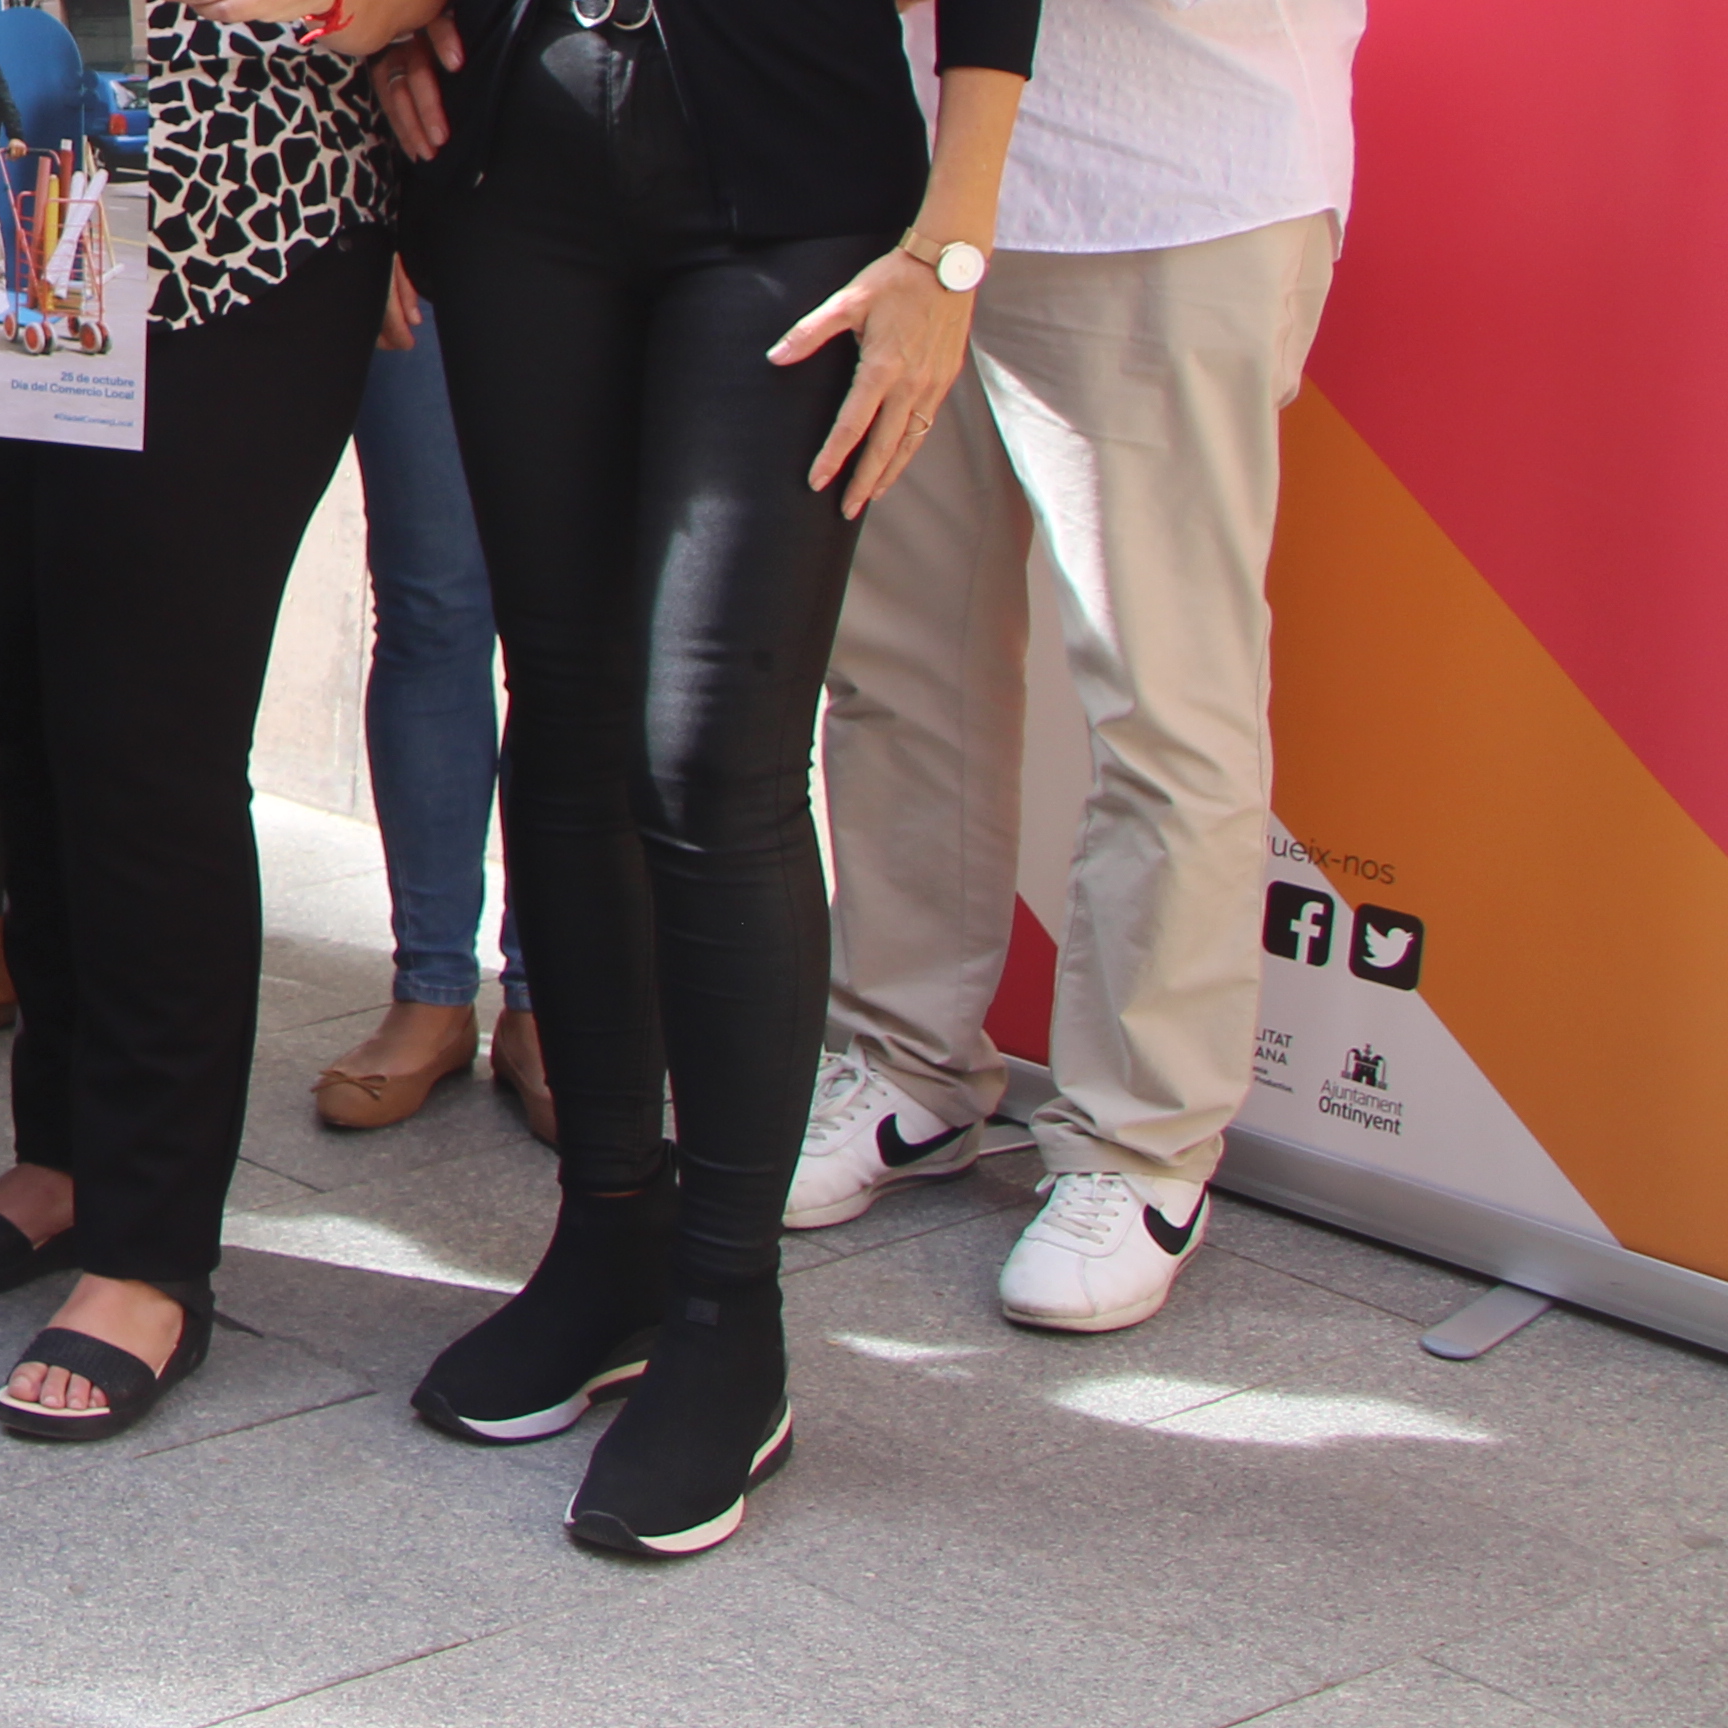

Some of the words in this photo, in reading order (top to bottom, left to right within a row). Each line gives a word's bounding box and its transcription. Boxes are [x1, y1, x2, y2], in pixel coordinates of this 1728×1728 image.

[1266, 834, 1396, 886] ueix-nos
[1318, 1095, 1402, 1136] Ontinyent
[1320, 1079, 1404, 1117] Ajuntament
